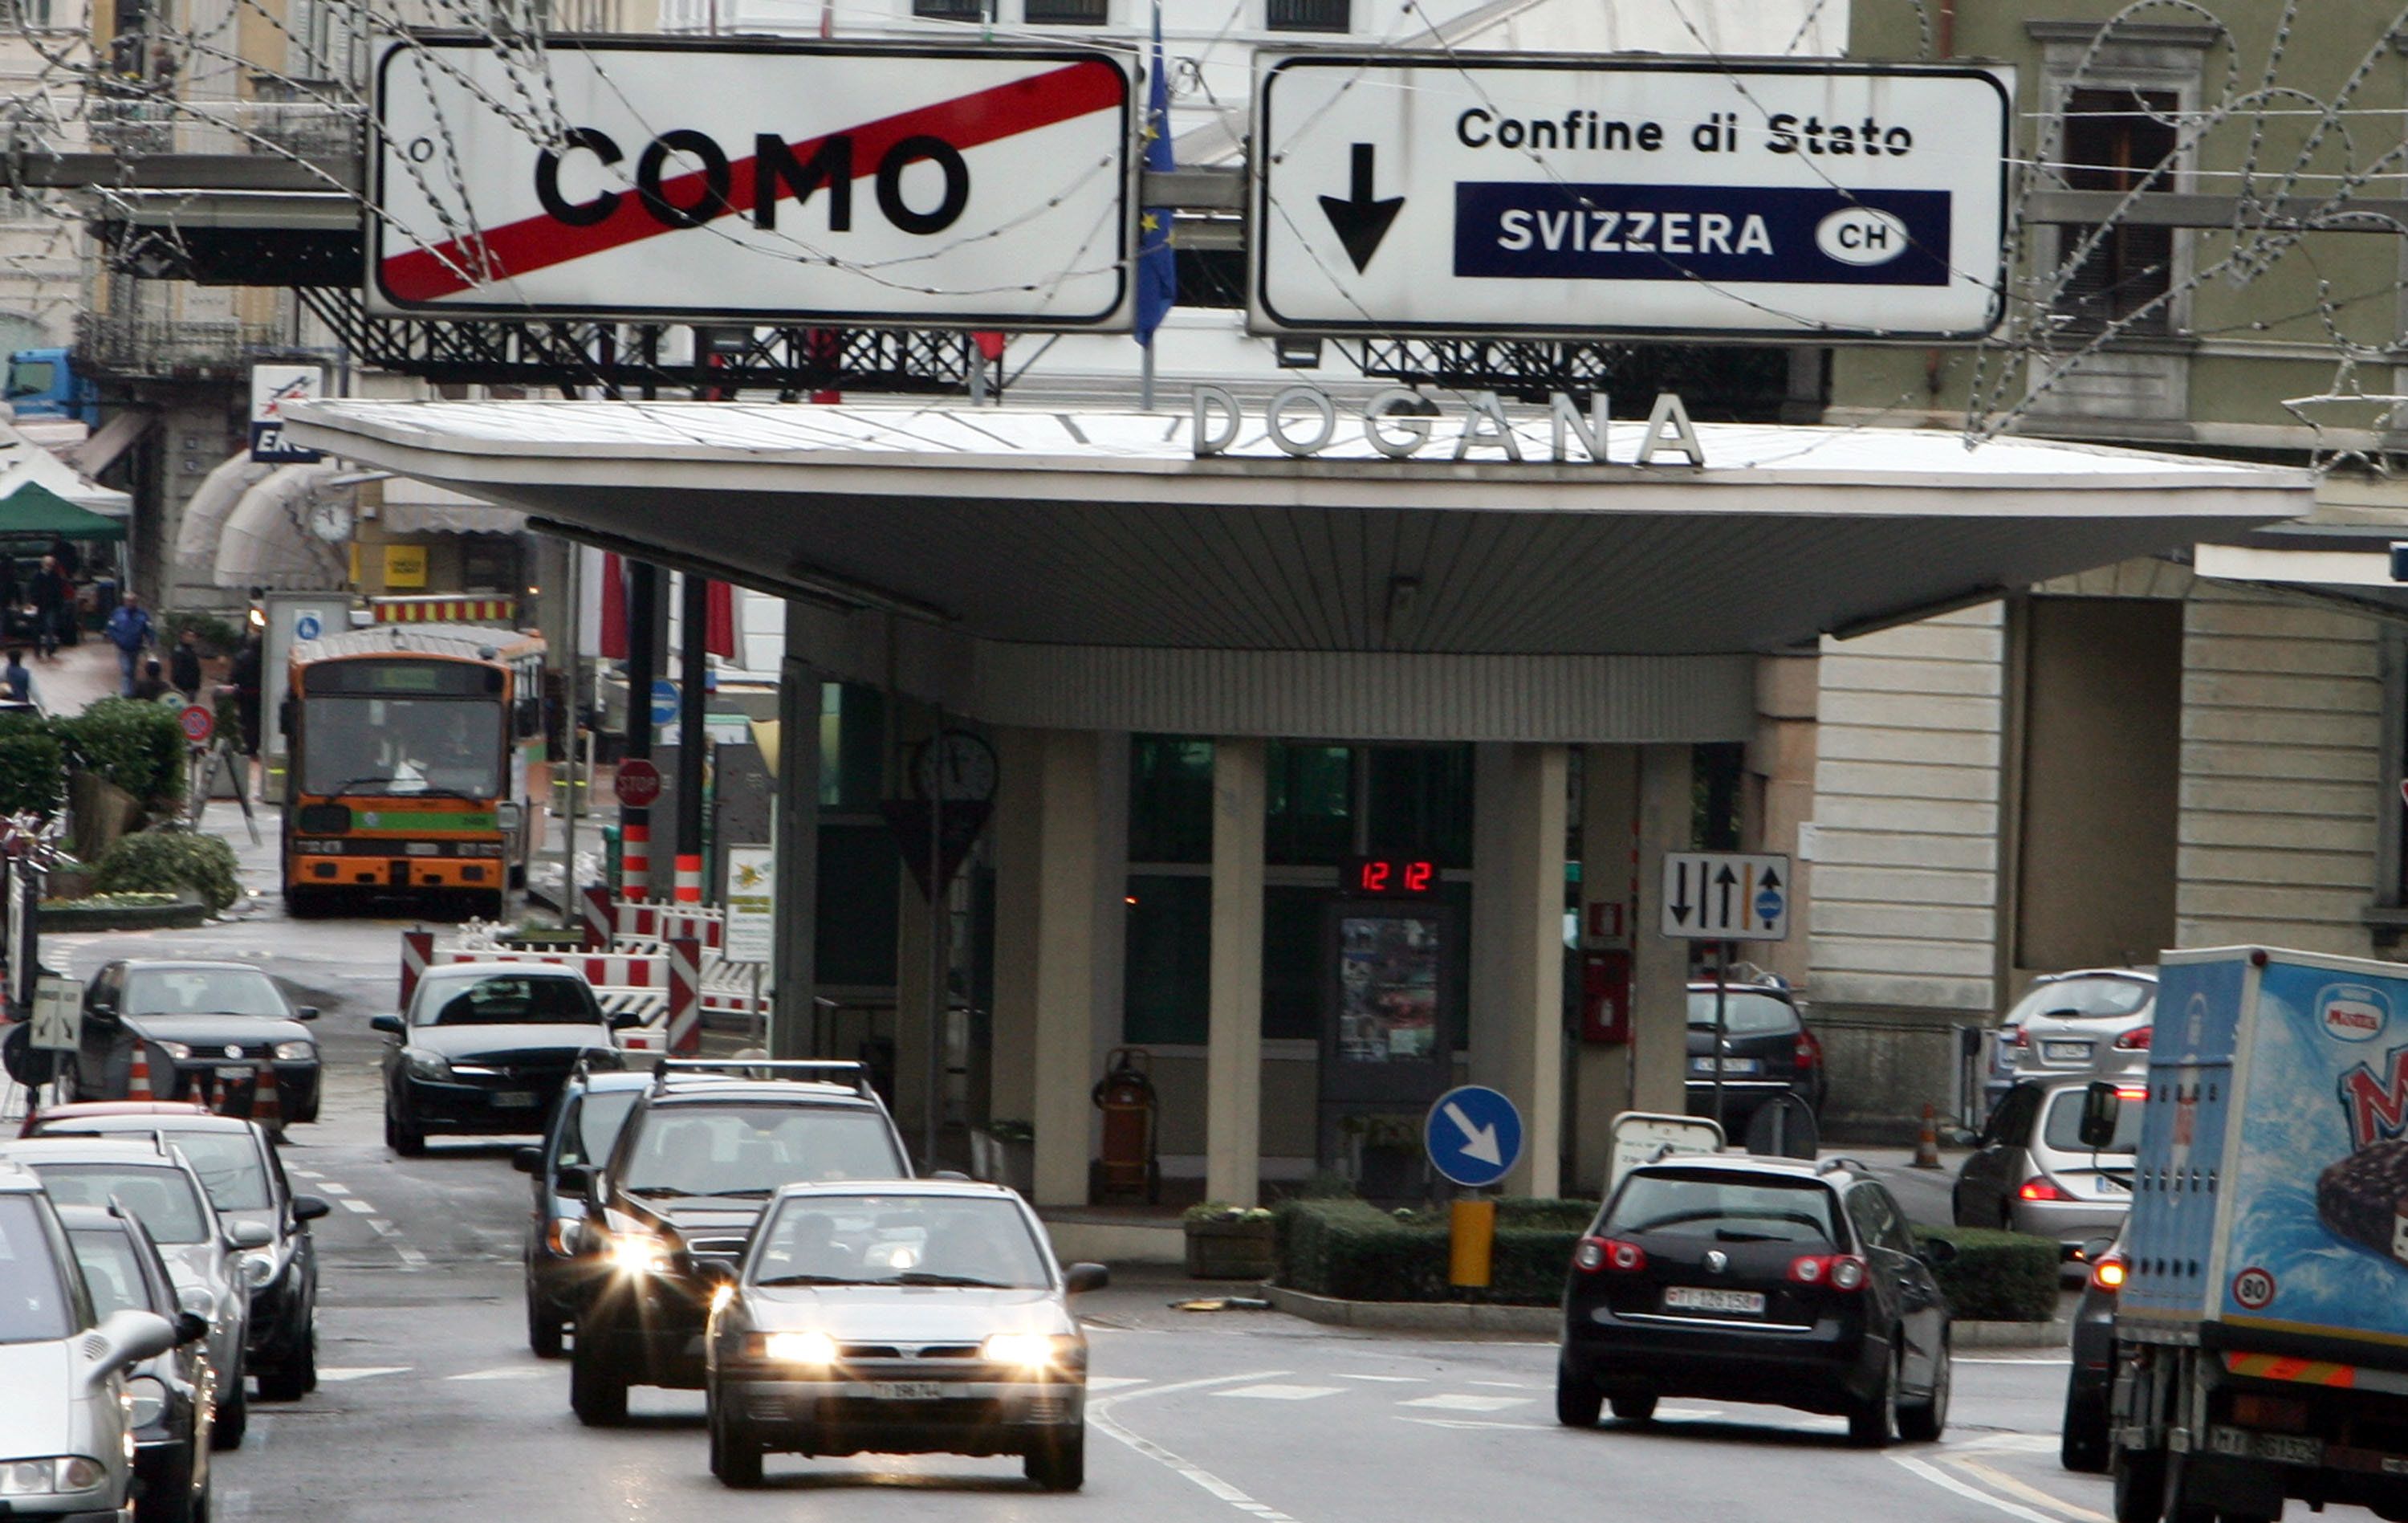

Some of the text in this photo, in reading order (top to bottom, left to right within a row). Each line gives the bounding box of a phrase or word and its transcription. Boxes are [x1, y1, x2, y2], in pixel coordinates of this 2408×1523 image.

[1457, 108, 1913, 157] Confine di Stato
[534, 126, 970, 236] COMO
[1497, 209, 1889, 255] SVIZZERA CH
[1193, 385, 1705, 466] DOGANA
[618, 775, 660, 795] STOP
[2241, 1277, 2266, 1301] 80
